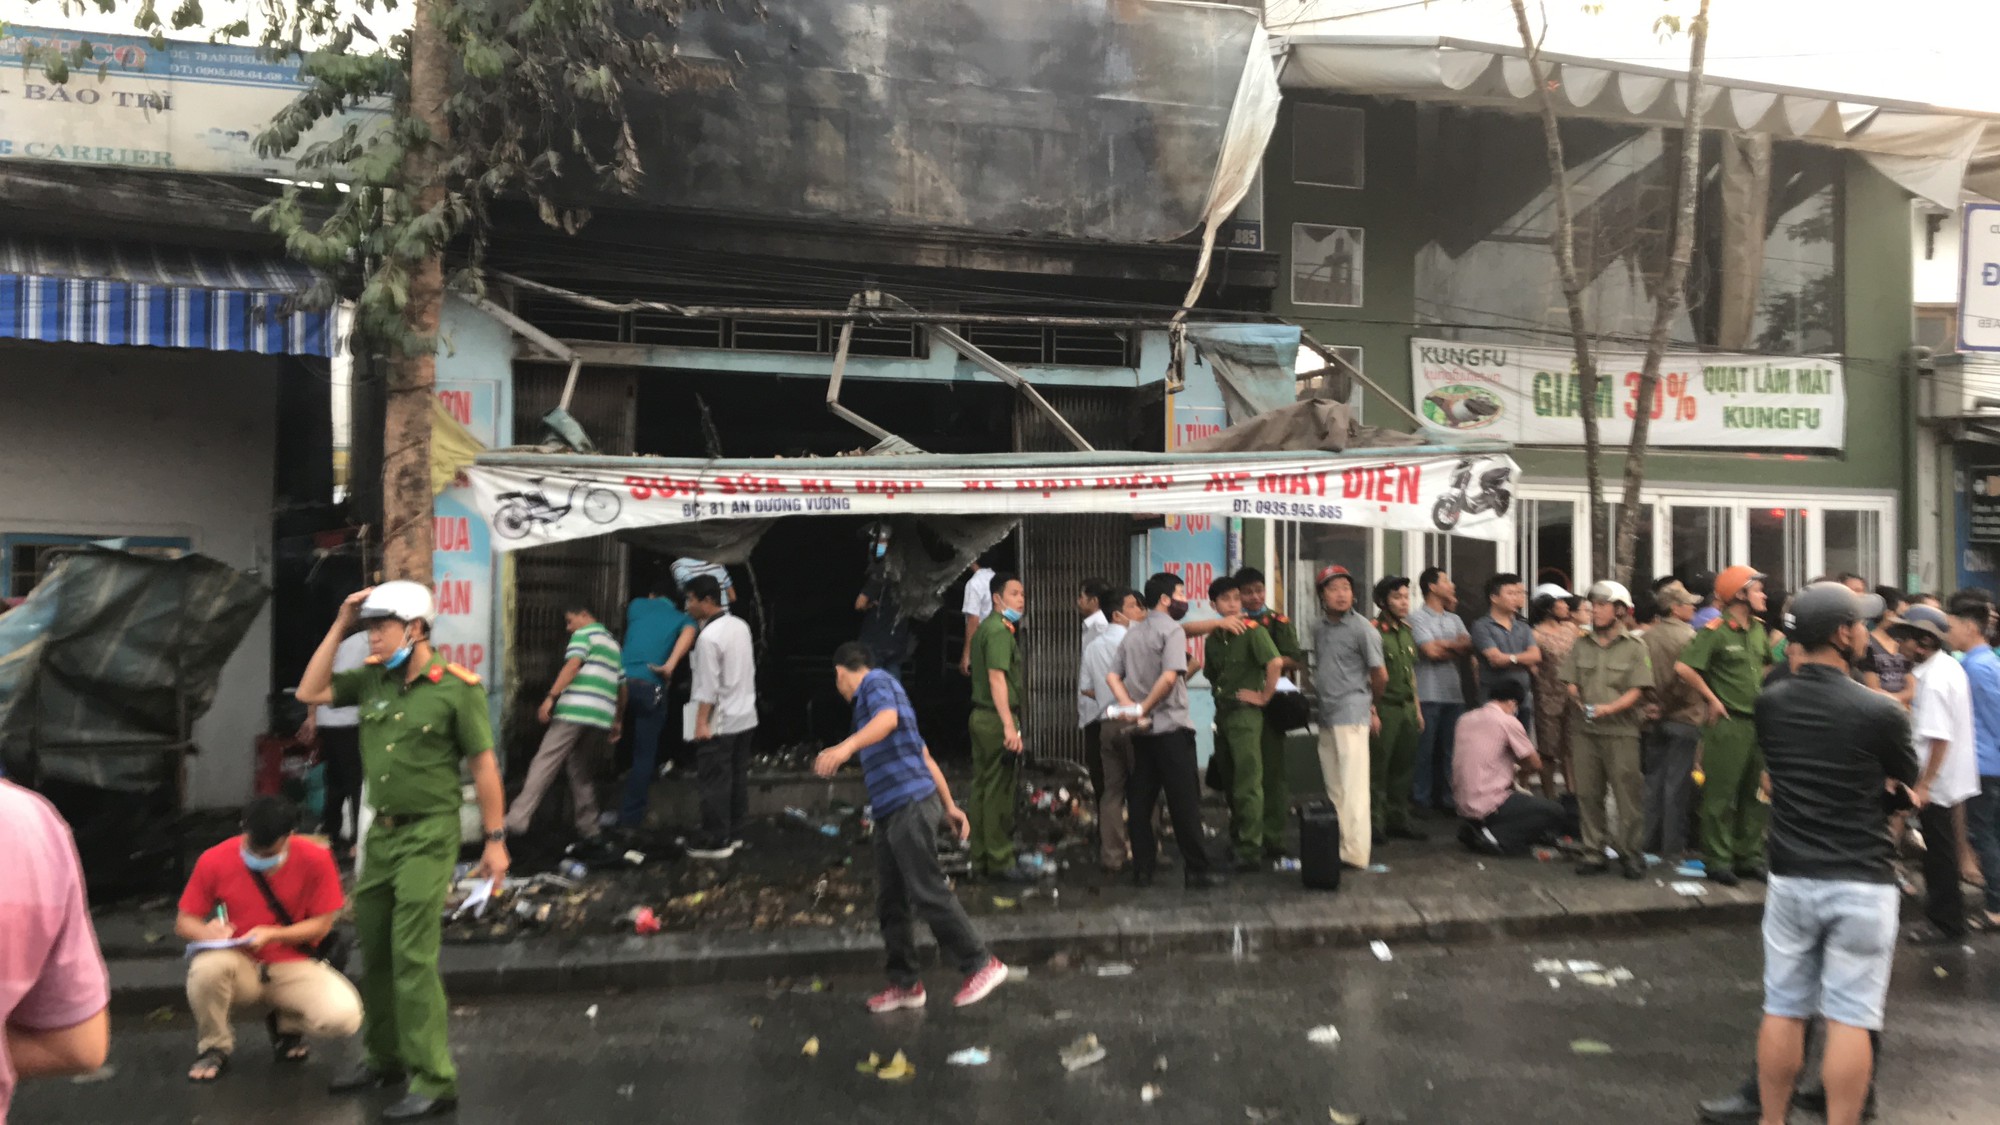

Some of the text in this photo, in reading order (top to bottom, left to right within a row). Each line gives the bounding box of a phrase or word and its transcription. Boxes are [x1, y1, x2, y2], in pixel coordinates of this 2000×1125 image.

[24, 142, 176, 167] CARRIER
[1421, 346, 1506, 367] KUNGFU
[1723, 405, 1821, 430] KUNGFU
[1341, 462, 1422, 512] ĐIỆN
[731, 501, 750, 514] AN
[433, 517, 471, 552] UA
[433, 573, 472, 616] ÁN
